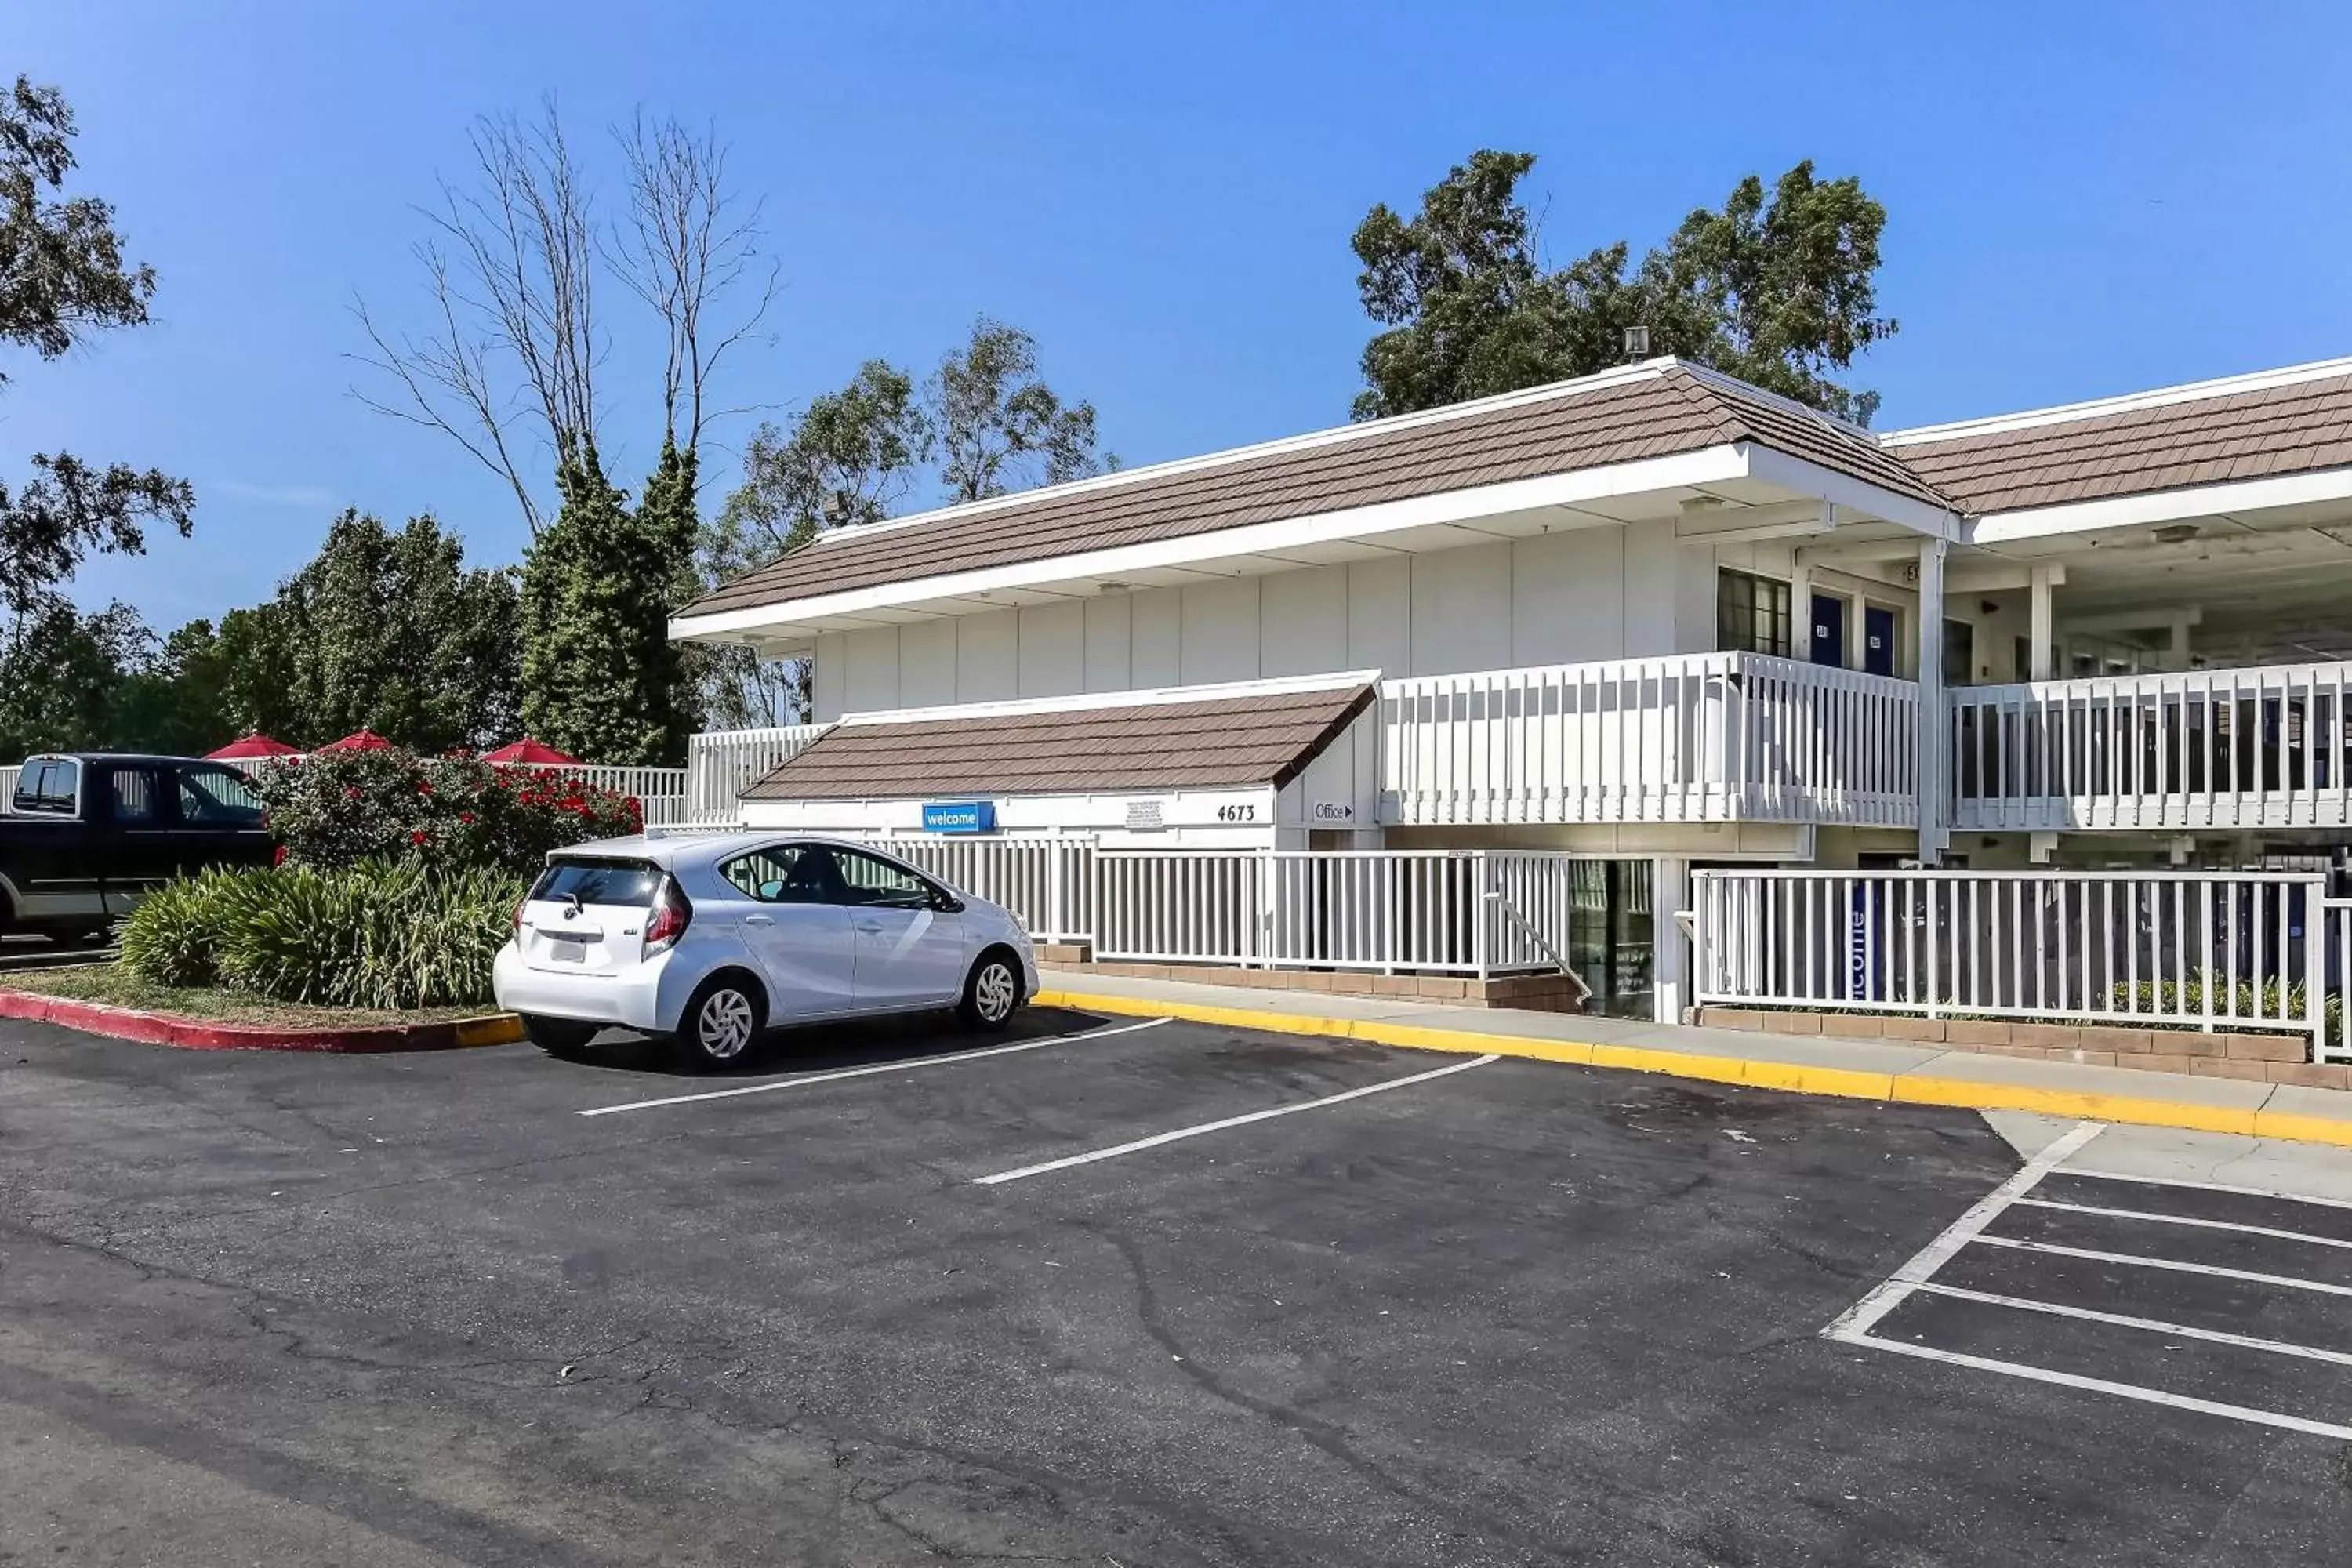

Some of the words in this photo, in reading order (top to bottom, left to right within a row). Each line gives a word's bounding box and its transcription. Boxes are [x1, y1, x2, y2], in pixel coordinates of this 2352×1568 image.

[927, 810, 976, 826] welcome
[1218, 804, 1255, 822] 4673
[1315, 803, 1344, 819] Office
